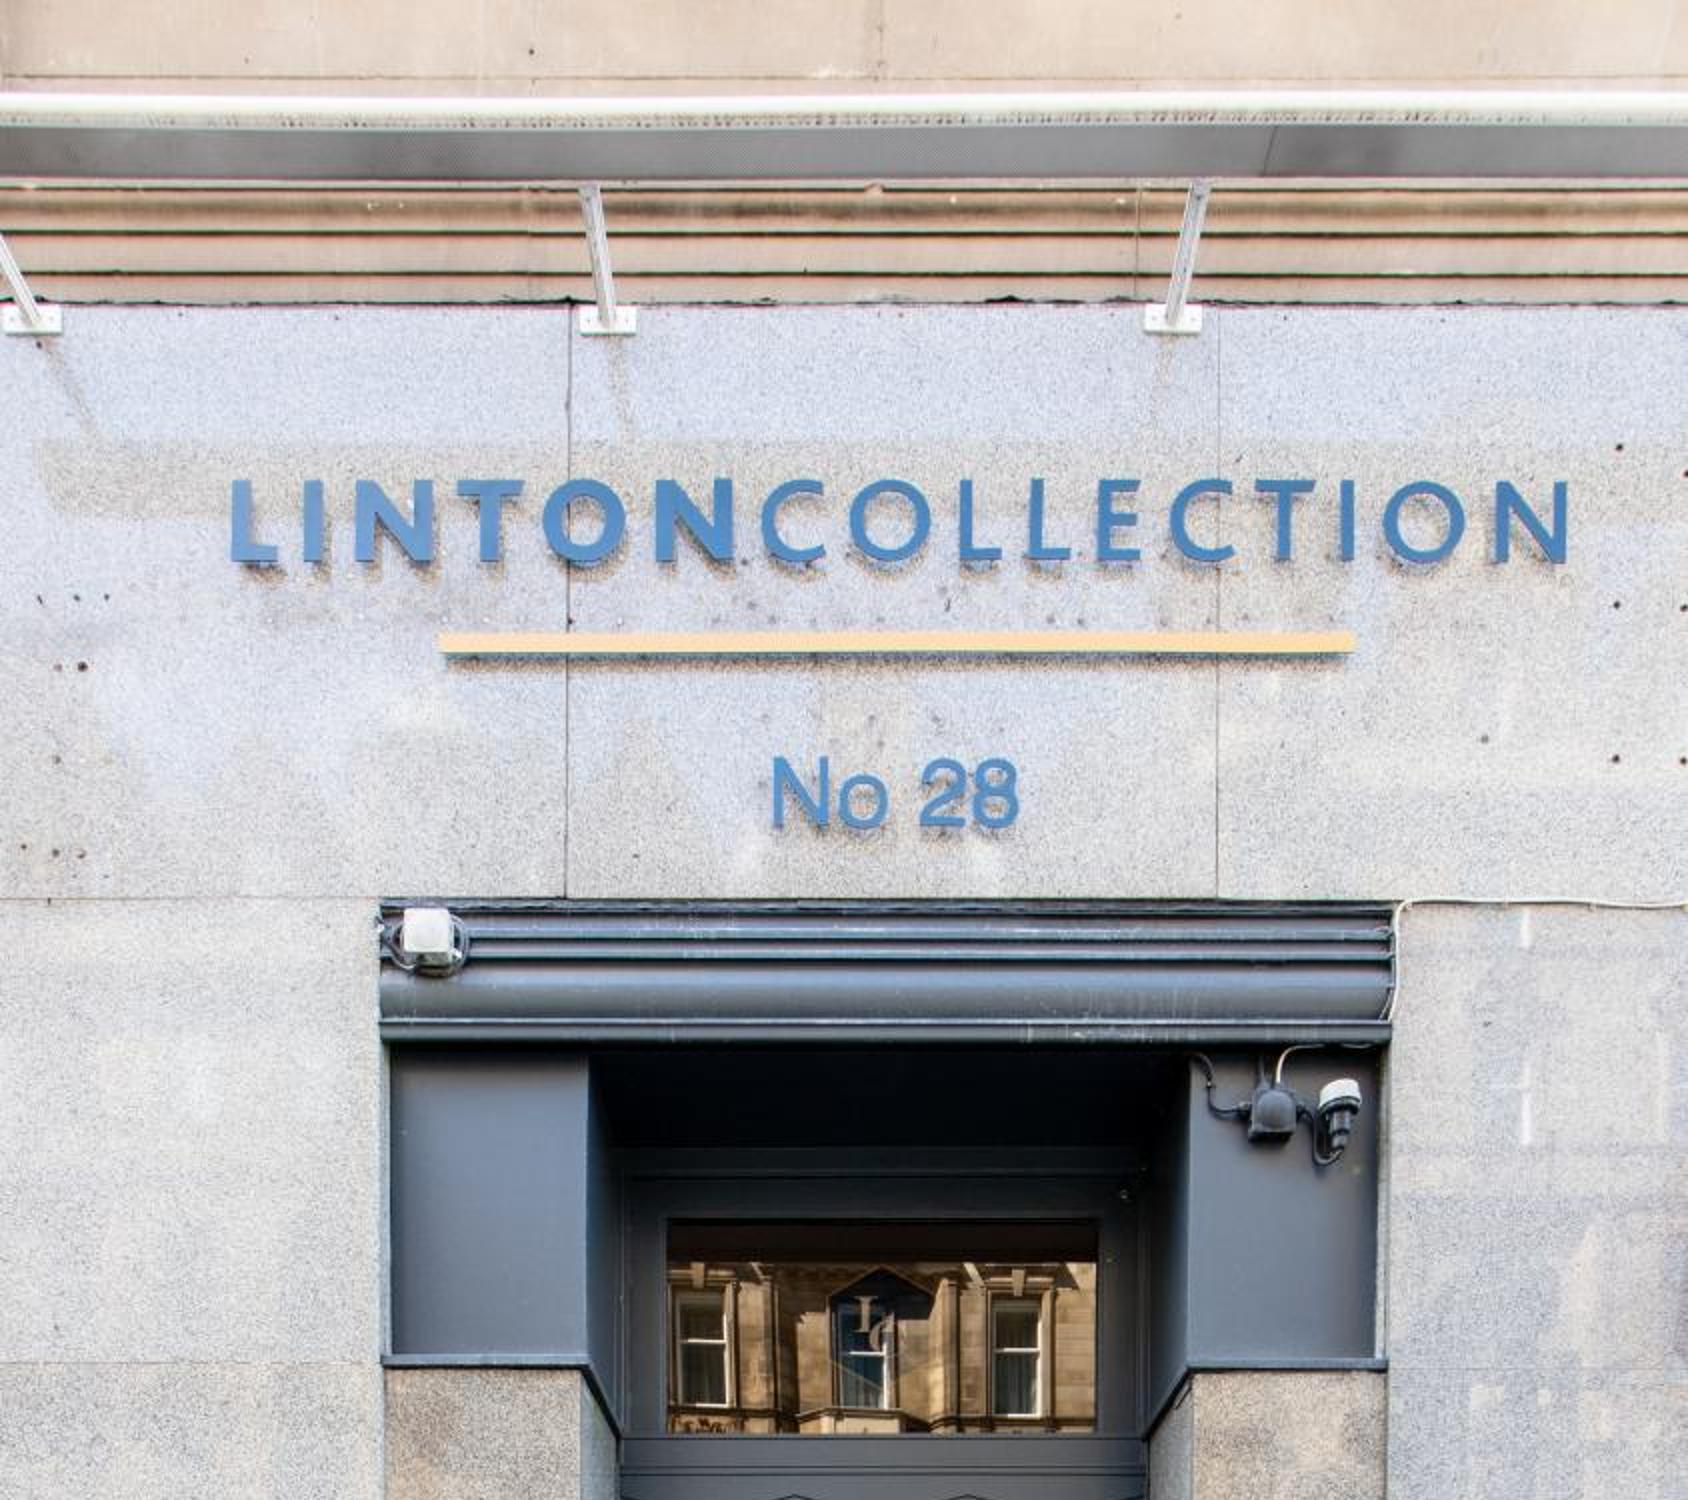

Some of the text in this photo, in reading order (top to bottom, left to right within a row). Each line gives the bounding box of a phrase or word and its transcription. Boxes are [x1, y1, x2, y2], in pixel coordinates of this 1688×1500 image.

[231, 479, 1568, 565] LINTONCOLLECTION
[772, 756, 1020, 829] No 28
